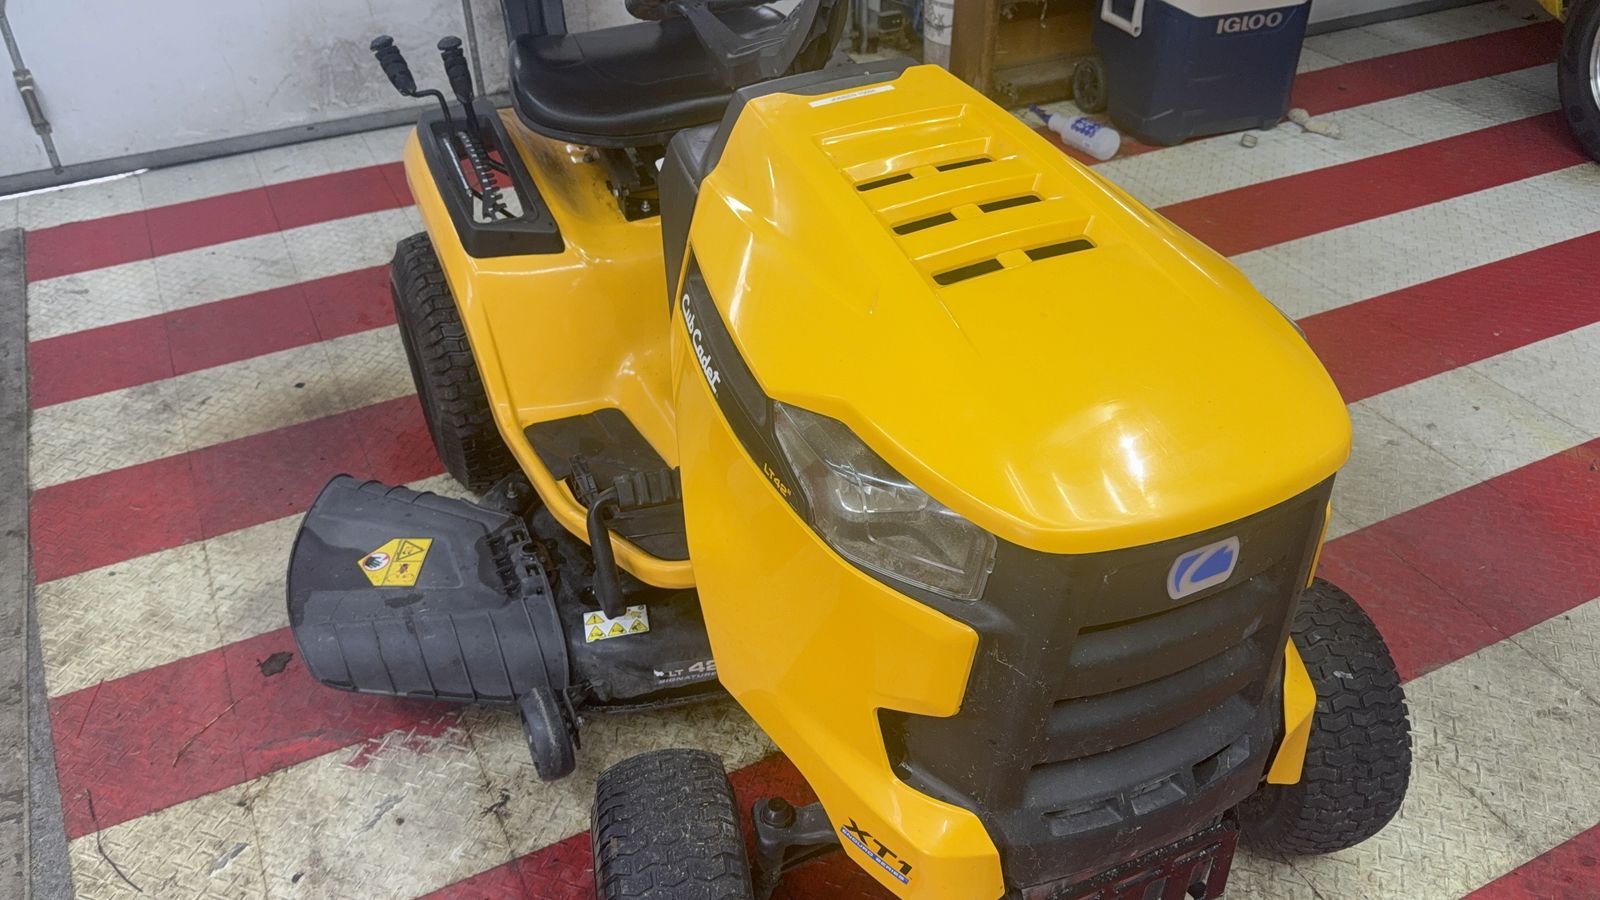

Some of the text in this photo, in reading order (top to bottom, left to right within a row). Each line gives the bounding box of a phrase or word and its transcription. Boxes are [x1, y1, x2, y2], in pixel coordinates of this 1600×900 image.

[1216, 11, 1283, 35] IGLOO
[682, 293, 721, 395] Cub Cadet
[668, 669, 684, 678] LT
[841, 828, 906, 882] ENDURO SERIES
[842, 815, 913, 876] XT1
